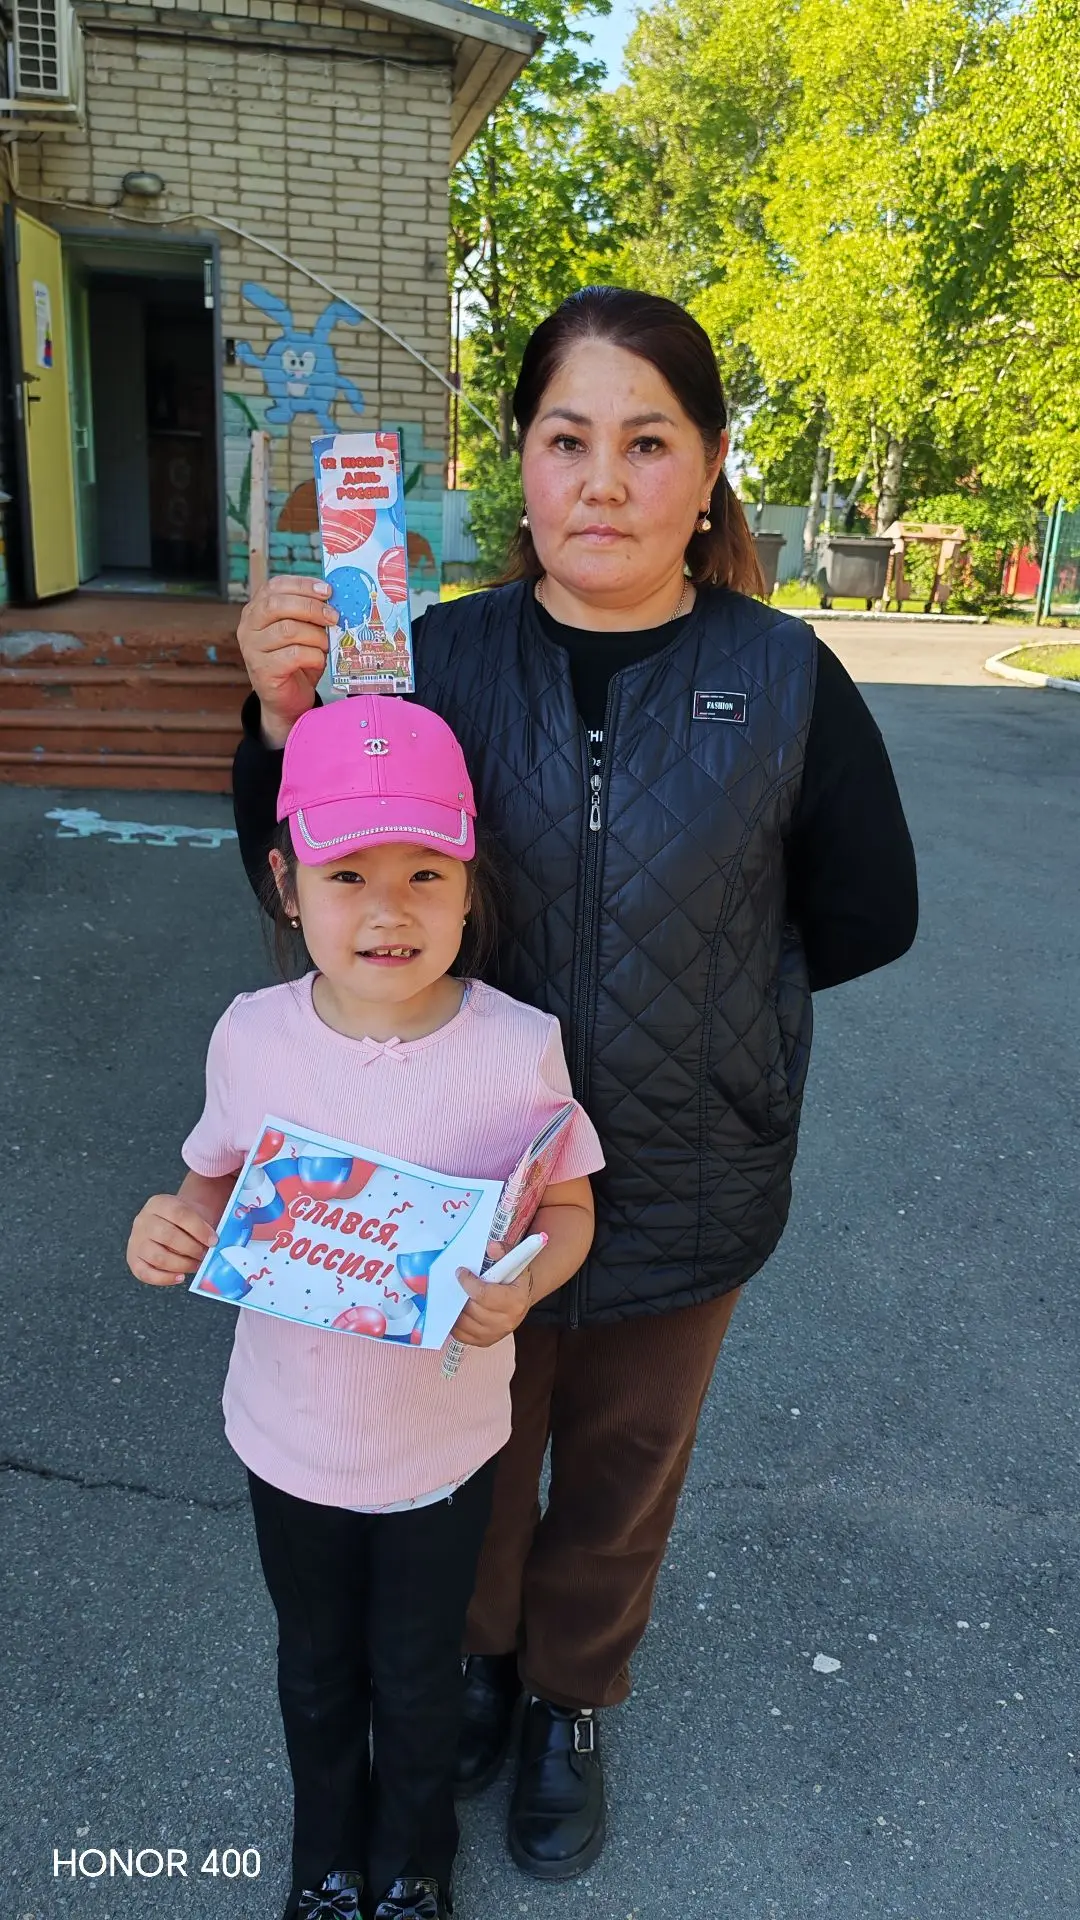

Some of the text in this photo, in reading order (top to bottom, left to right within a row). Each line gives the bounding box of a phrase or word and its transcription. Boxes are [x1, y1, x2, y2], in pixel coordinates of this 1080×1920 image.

[321, 457, 337, 470] 12
[341, 456, 384, 469] ИЮНЯ
[343, 471, 381, 485] ДЕНЬ
[336, 486, 389, 500] РОССИИ
[706, 701, 734, 710] FASHION
[289, 1196, 399, 1251] СЛАВСЯ,
[269, 1231, 394, 1285] РОССИЯ!
